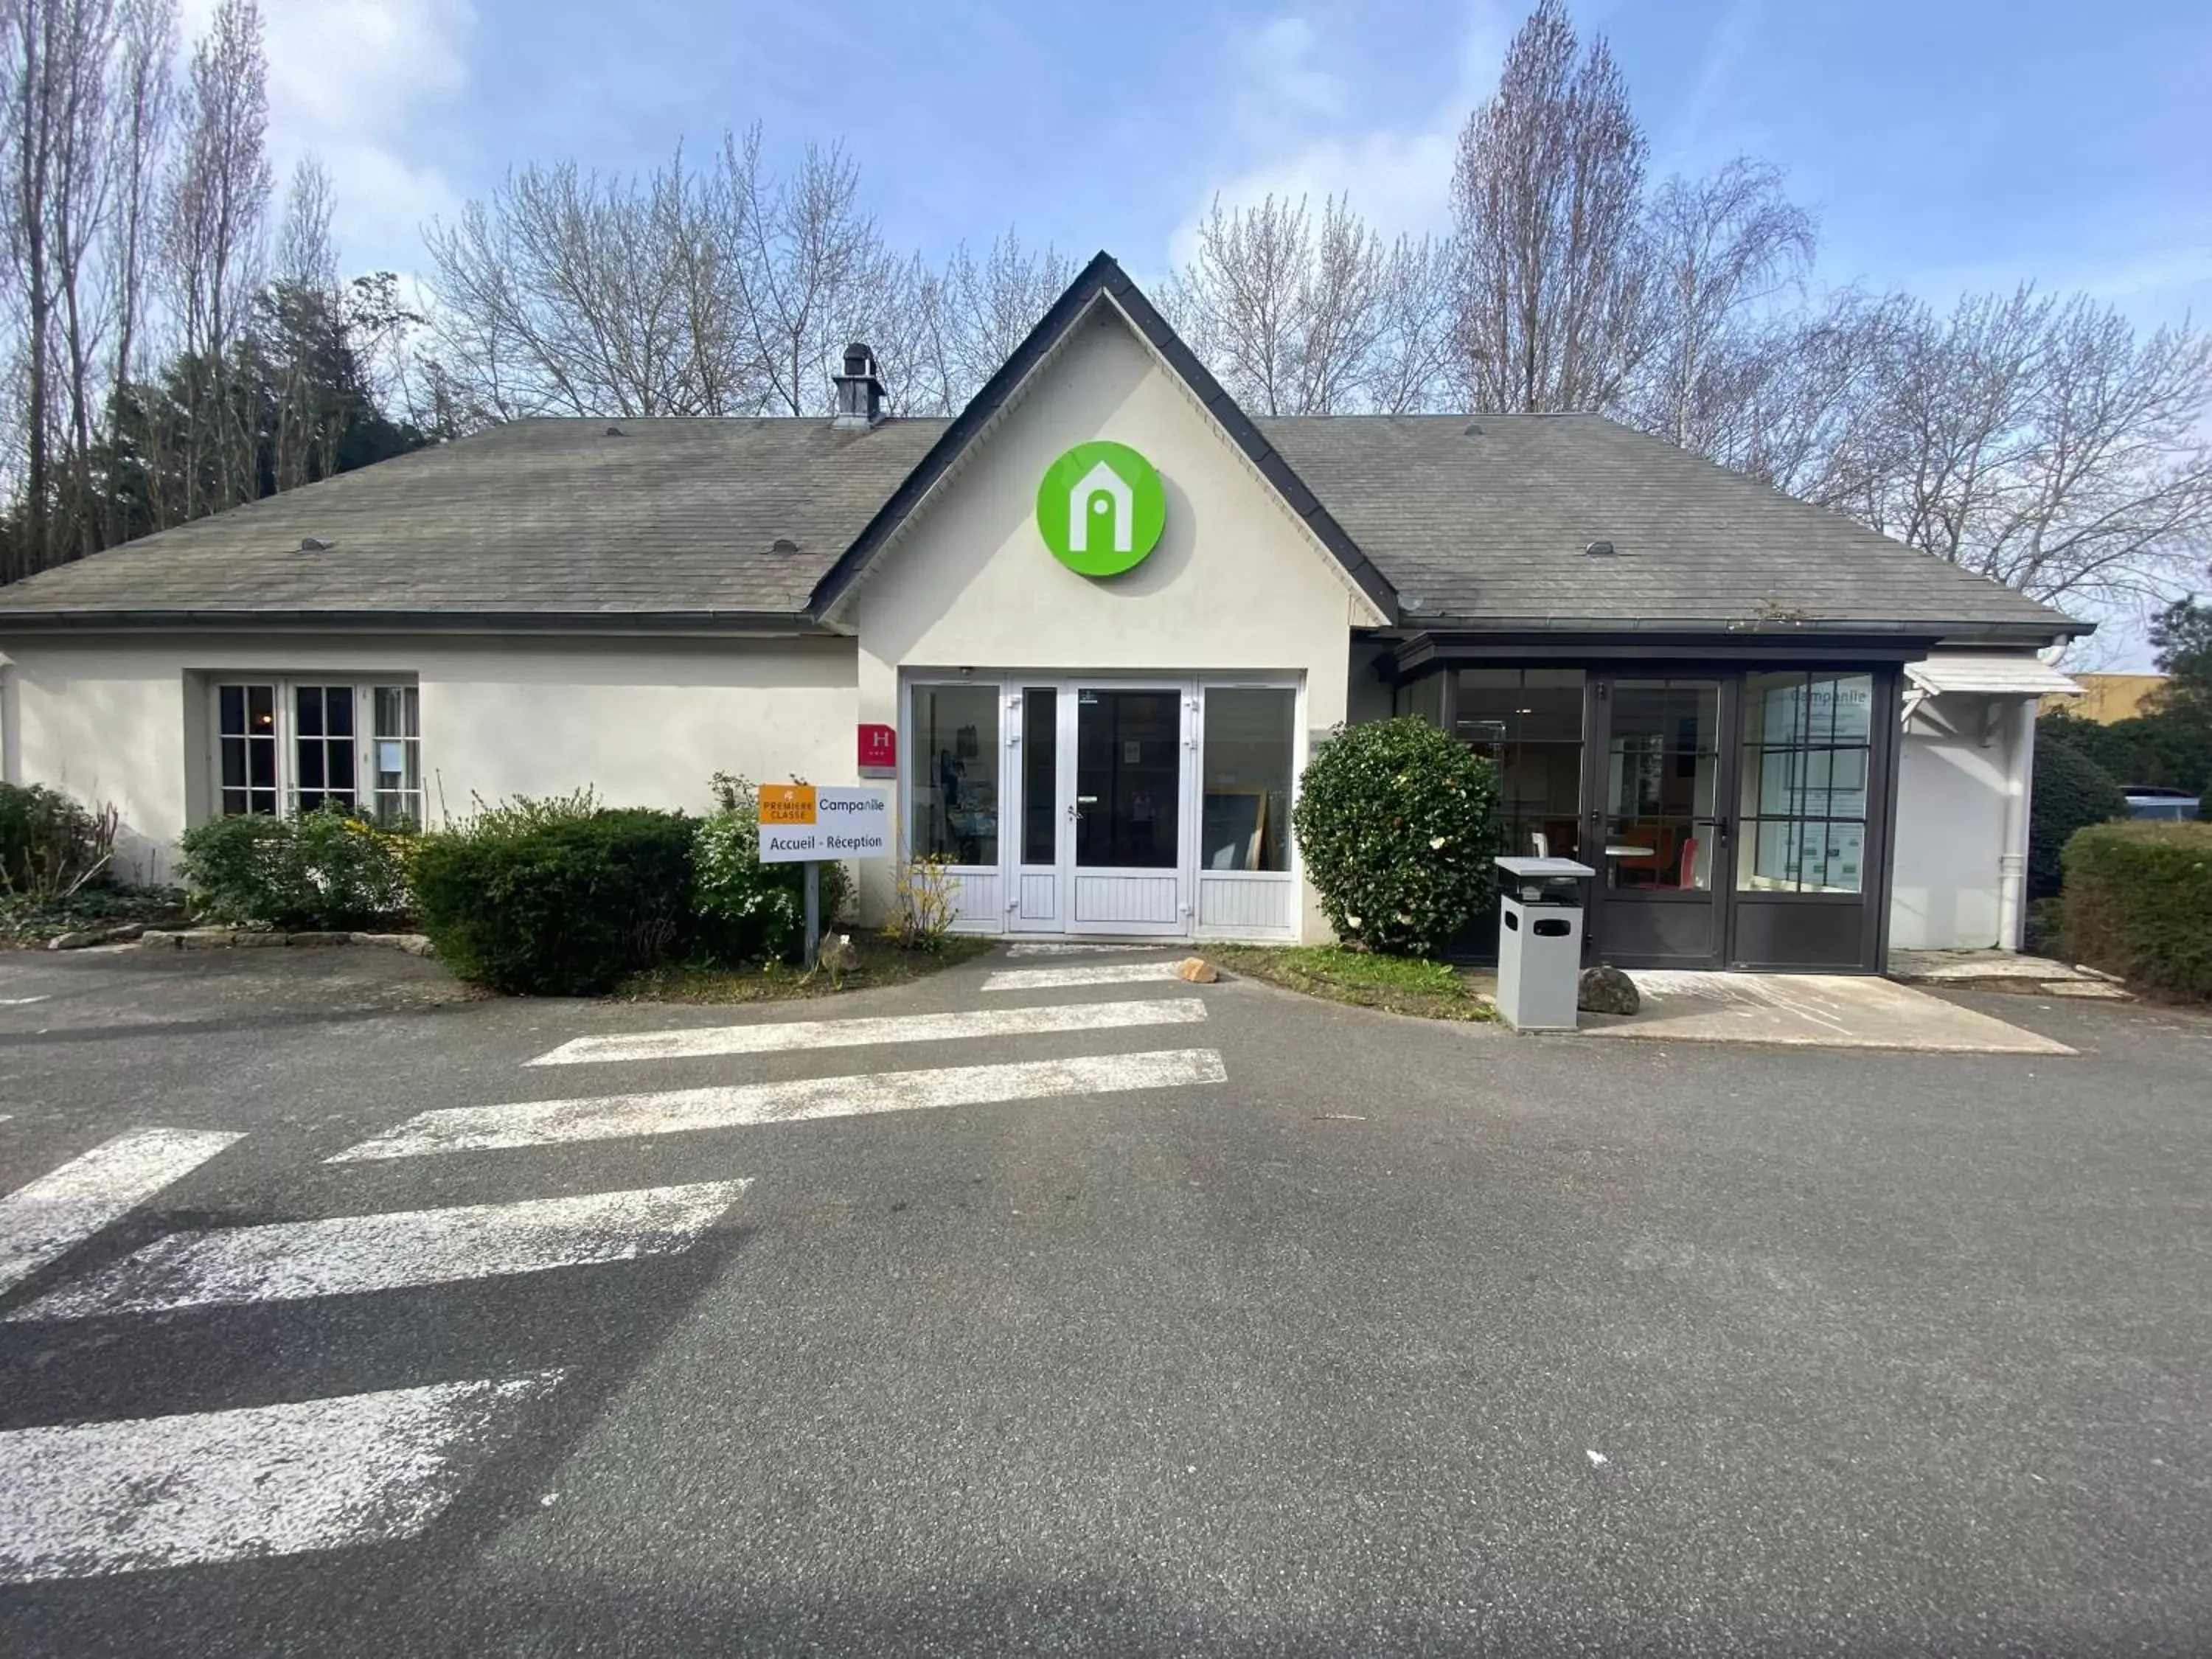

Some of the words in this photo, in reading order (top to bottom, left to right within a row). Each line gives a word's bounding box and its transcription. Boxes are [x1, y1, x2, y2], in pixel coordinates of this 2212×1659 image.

[873, 731, 889, 746] H
[819, 799, 885, 813] Campanile
[771, 811, 805, 819] CLASSE
[771, 836, 815, 849] Accueil
[827, 835, 882, 851] Réception
